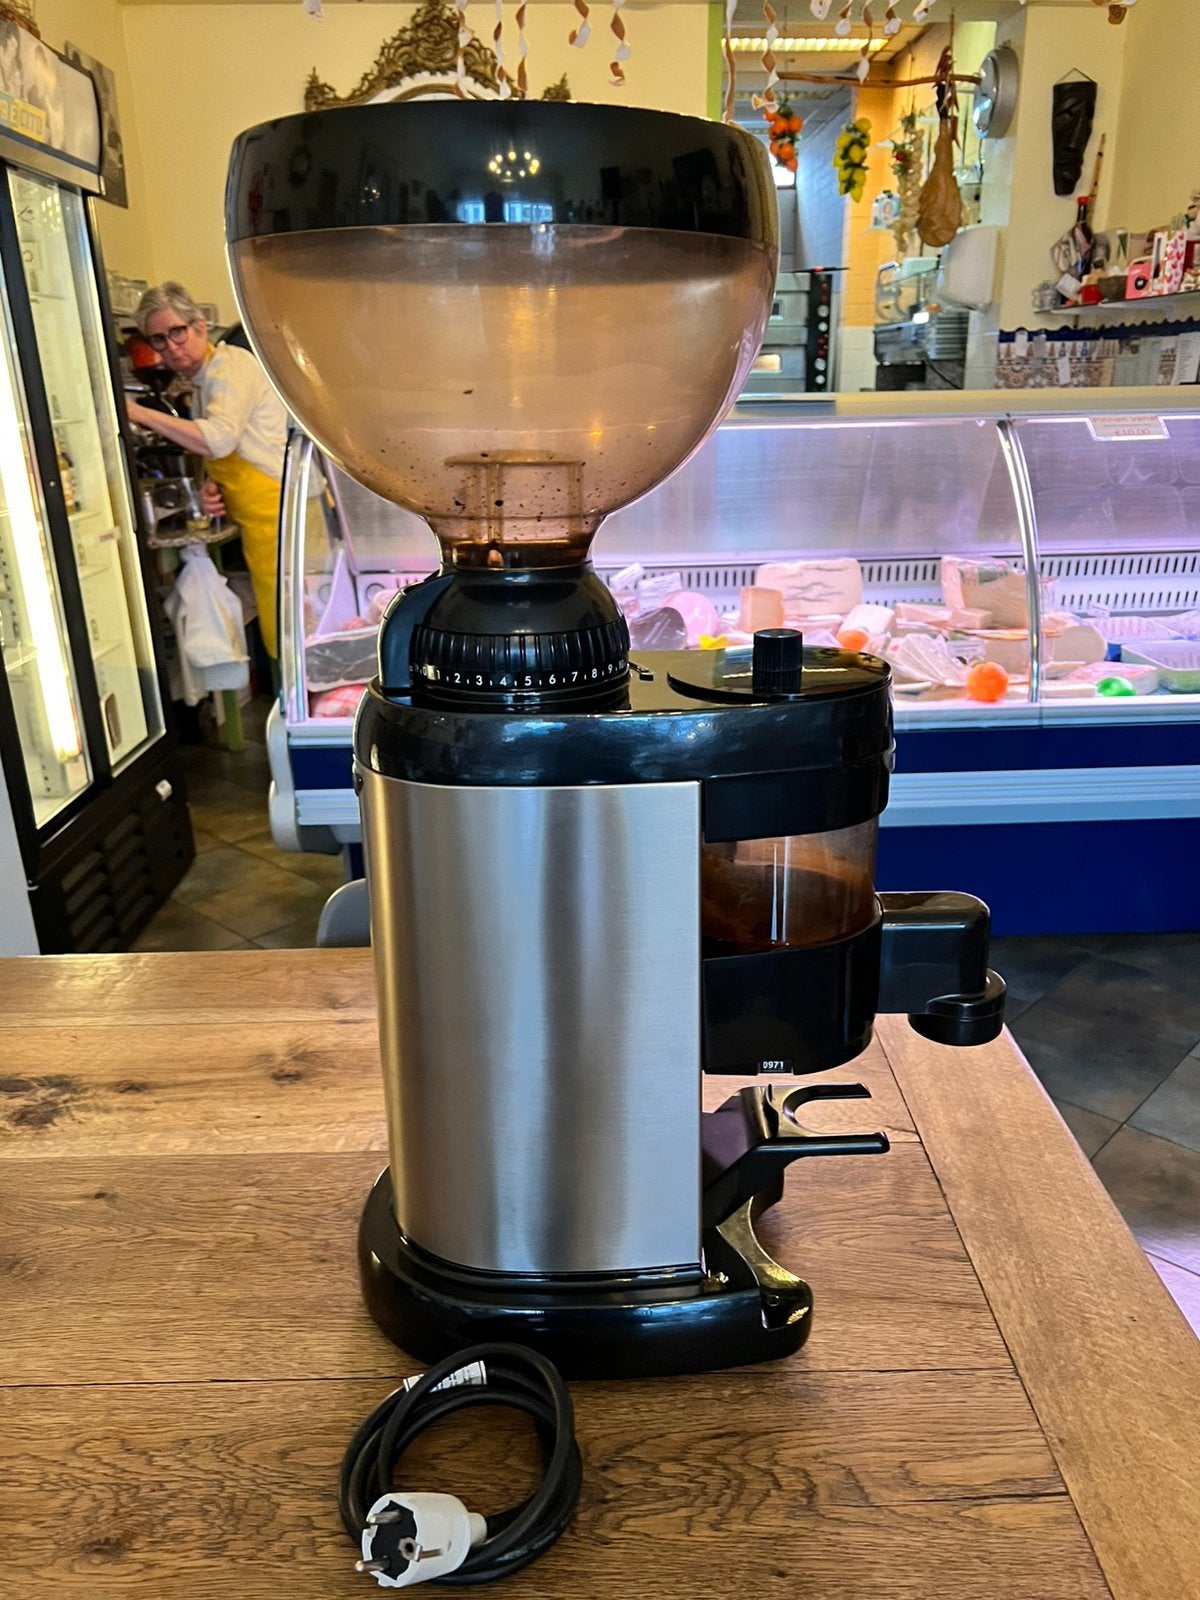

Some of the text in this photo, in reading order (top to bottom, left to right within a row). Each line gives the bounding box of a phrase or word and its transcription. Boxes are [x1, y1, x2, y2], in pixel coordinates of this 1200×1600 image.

[454, 672, 461, 684] 2
[475, 675, 483, 686] 3
[499, 676, 507, 686] 4
[524, 676, 532, 686] 5
[549, 674, 556, 685] 6
[571, 671, 578, 682] 7
[591, 668, 598, 679] 8
[607, 663, 613, 674] 9
[762, 1060, 784, 1069] 0971
